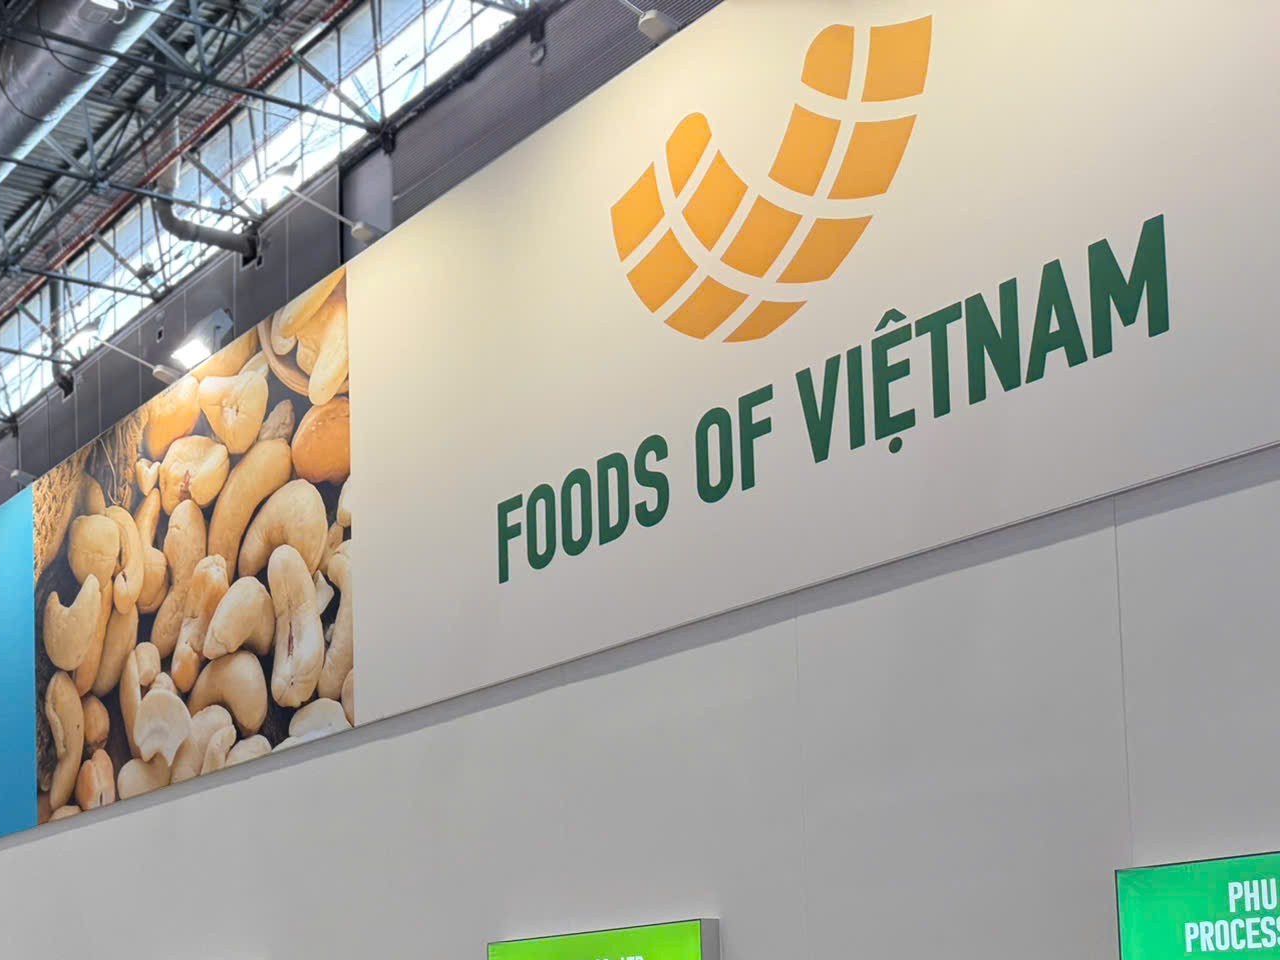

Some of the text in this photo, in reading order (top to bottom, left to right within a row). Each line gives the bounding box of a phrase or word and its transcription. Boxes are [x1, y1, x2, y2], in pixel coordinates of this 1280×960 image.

[497, 214, 1170, 584] FOODS OF VIỆTNAM
[1228, 878, 1277, 912] PHU
